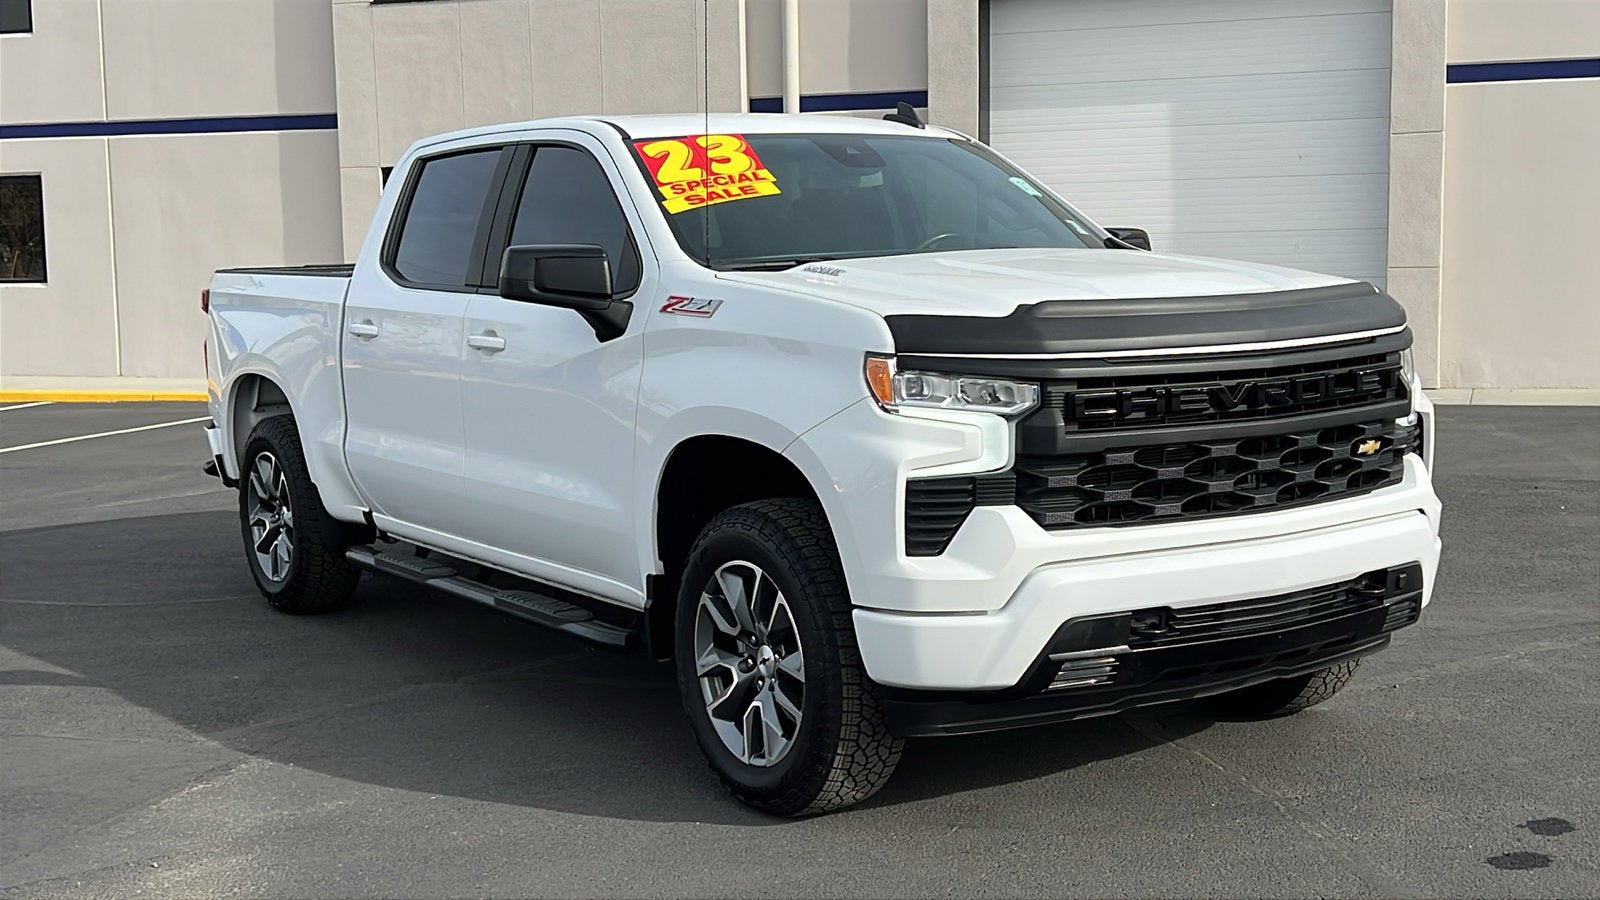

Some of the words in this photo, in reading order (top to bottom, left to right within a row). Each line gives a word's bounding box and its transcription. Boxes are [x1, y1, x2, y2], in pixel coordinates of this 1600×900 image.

[641, 134, 757, 183] 23
[670, 171, 768, 195] SPECIAL
[684, 185, 758, 206] SALE
